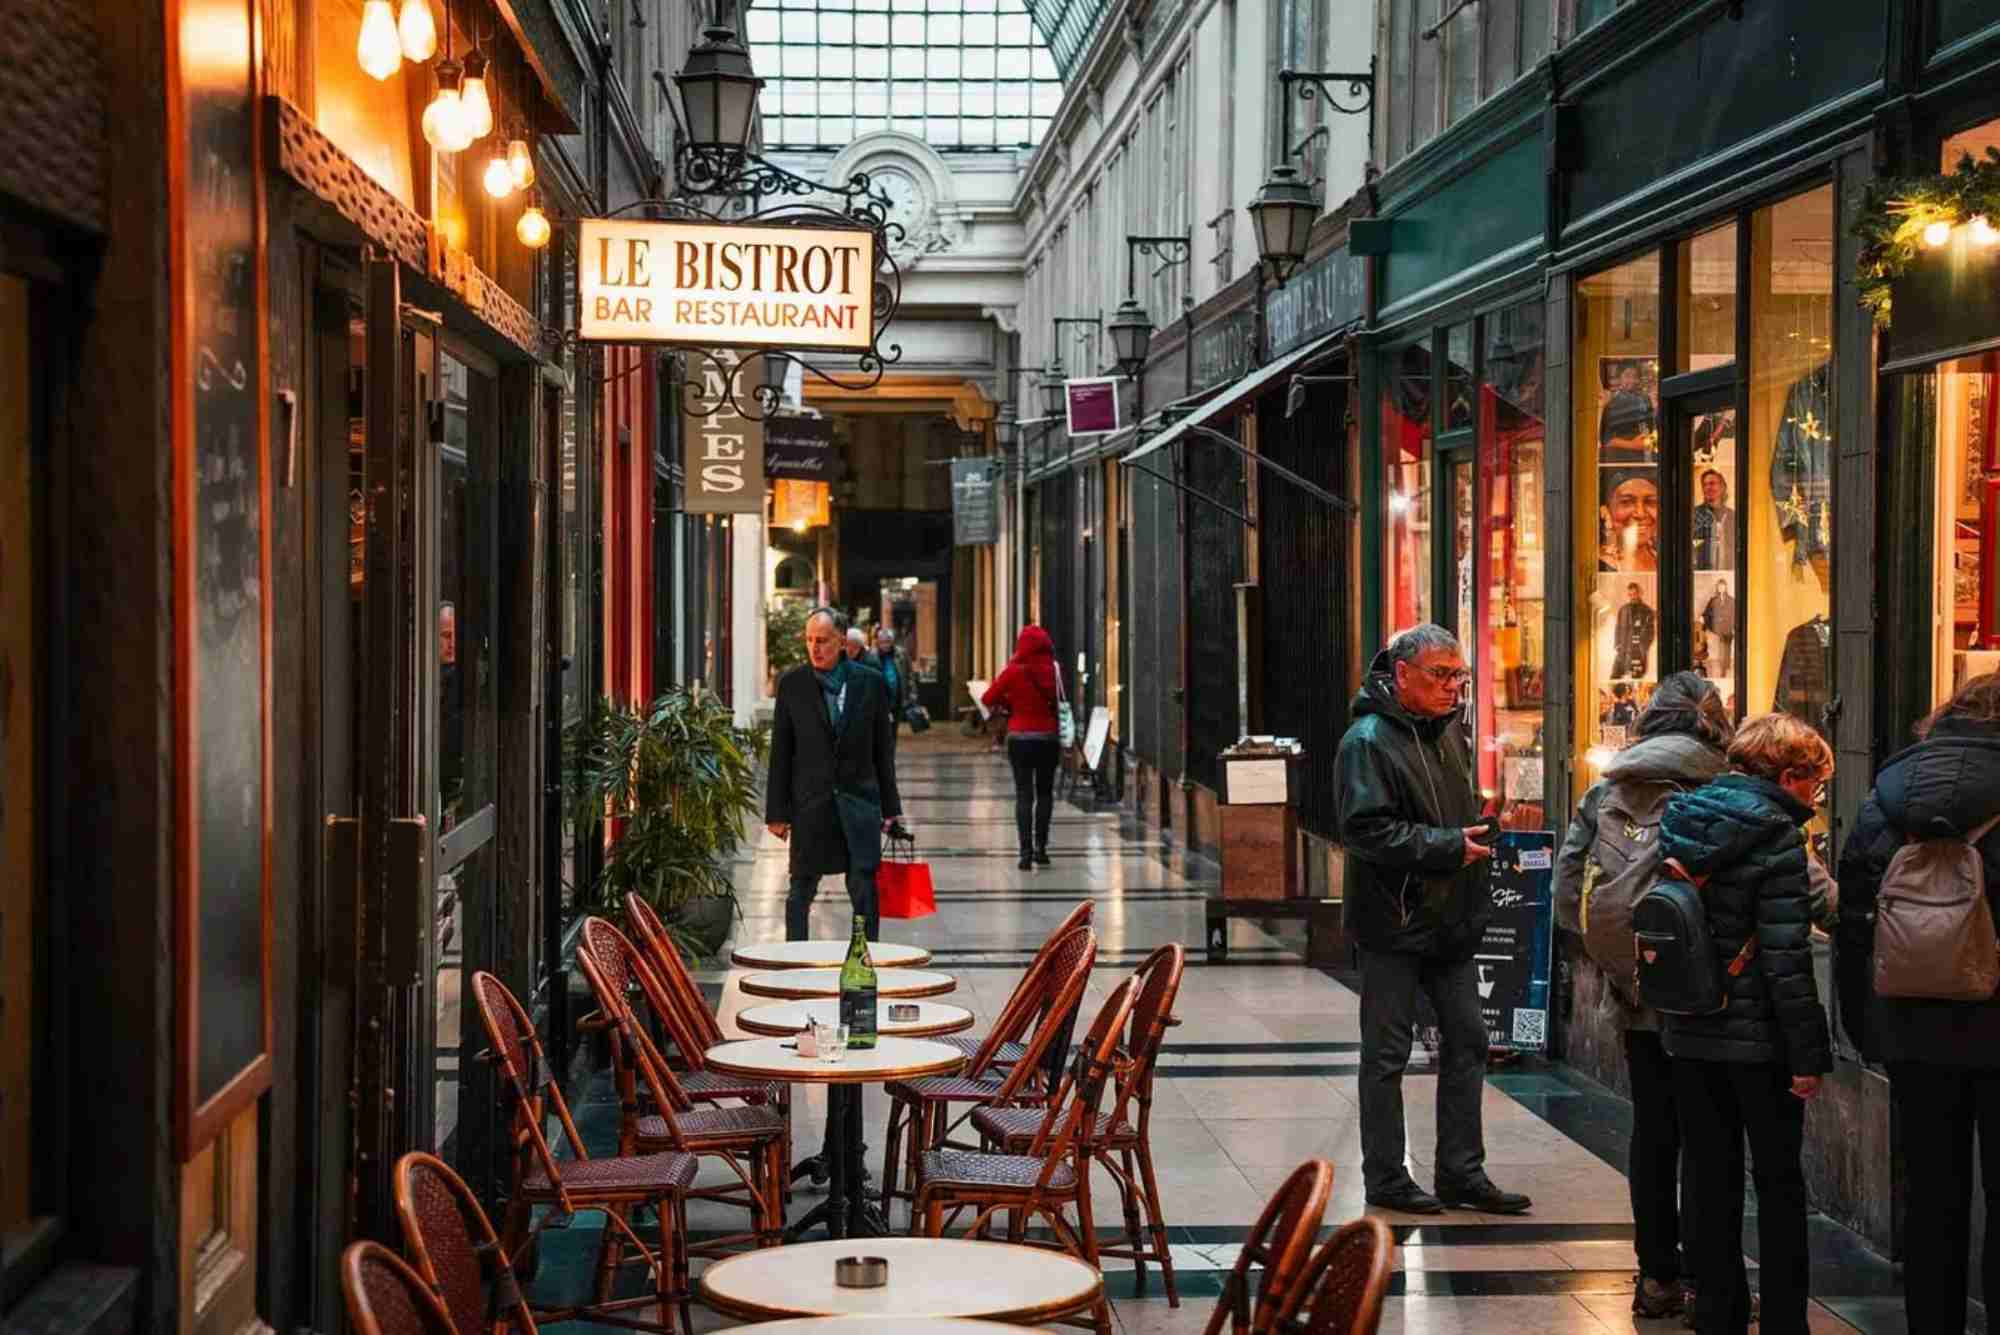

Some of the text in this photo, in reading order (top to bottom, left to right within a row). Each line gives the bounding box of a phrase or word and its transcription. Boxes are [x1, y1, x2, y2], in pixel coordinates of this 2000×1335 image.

[597, 237, 860, 296] LE BISTROT
[594, 295, 860, 330] BAR RESTAURANT
